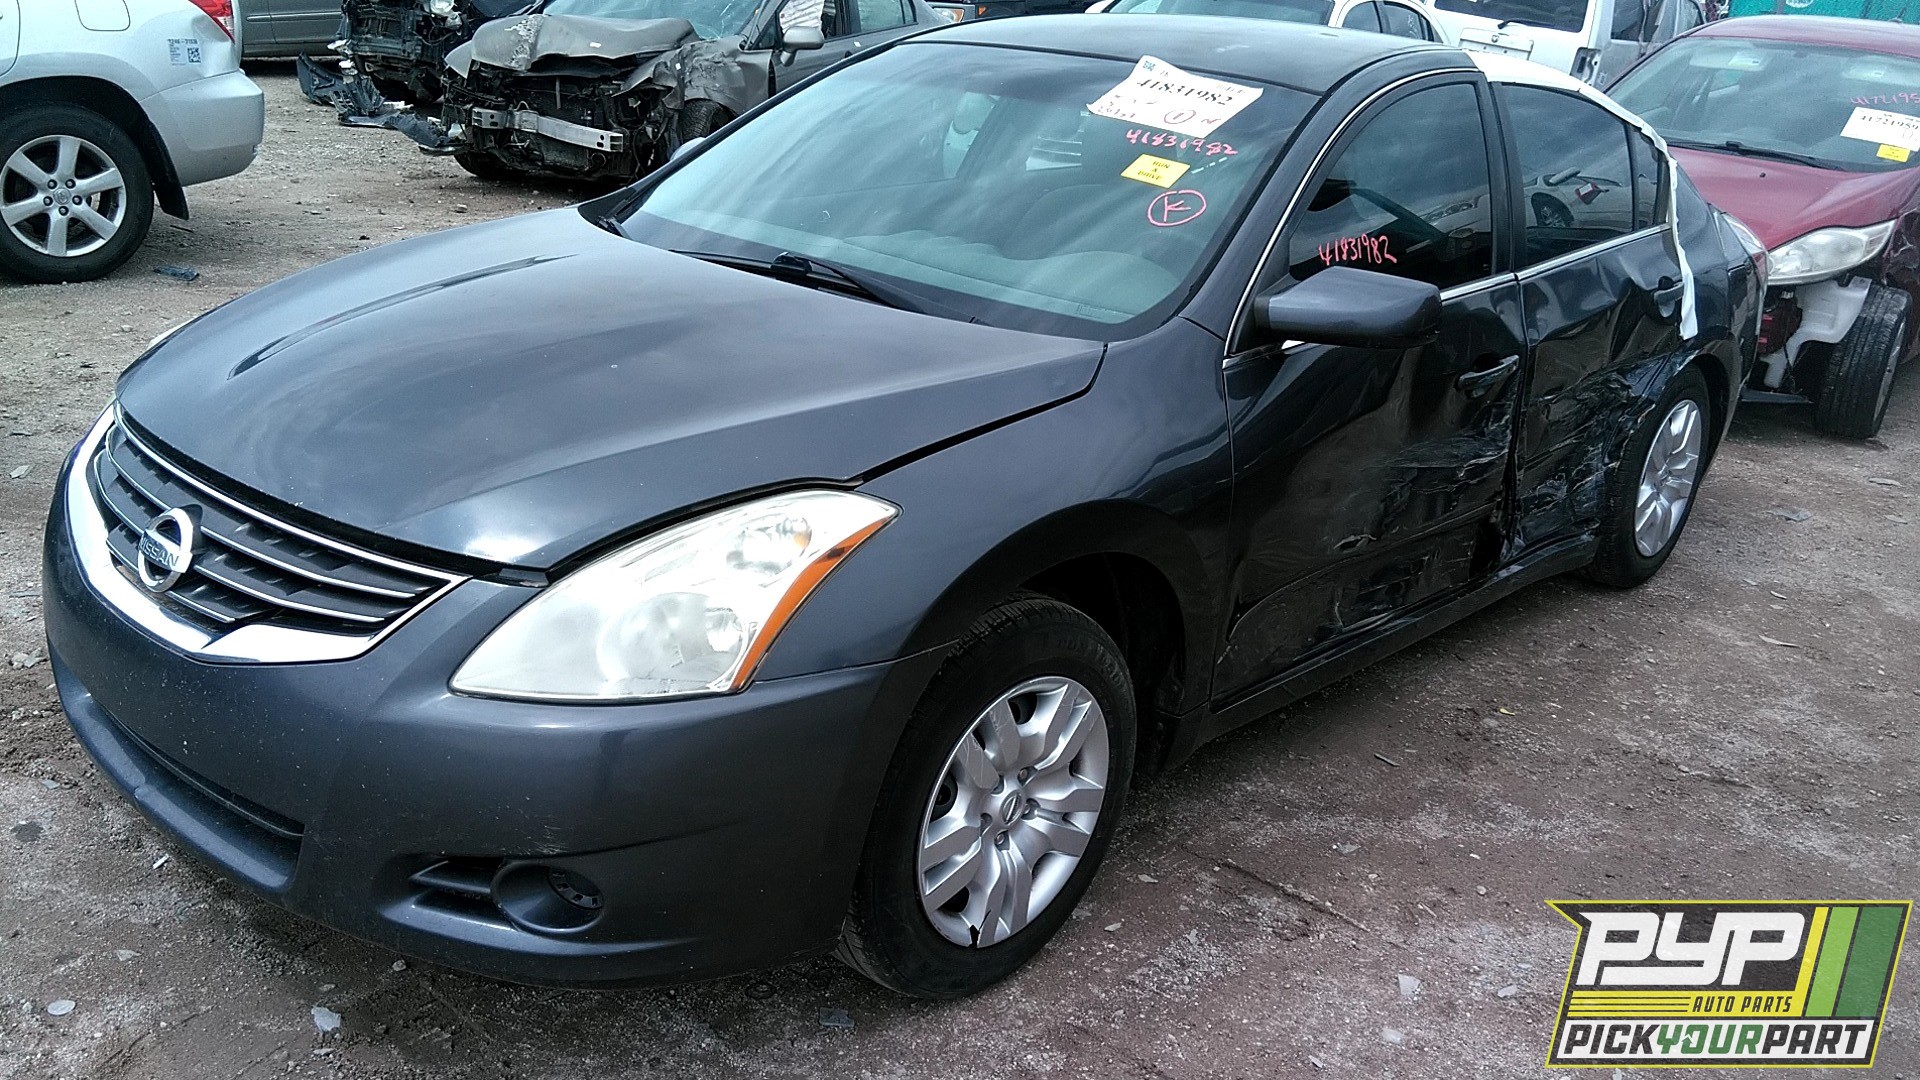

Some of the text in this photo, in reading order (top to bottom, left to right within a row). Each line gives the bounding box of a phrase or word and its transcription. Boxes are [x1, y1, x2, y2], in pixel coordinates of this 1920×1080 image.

[1137, 79, 1233, 106] 41831982
[1318, 233, 1398, 266] 41831982
[139, 536, 180, 567] NISSAN
